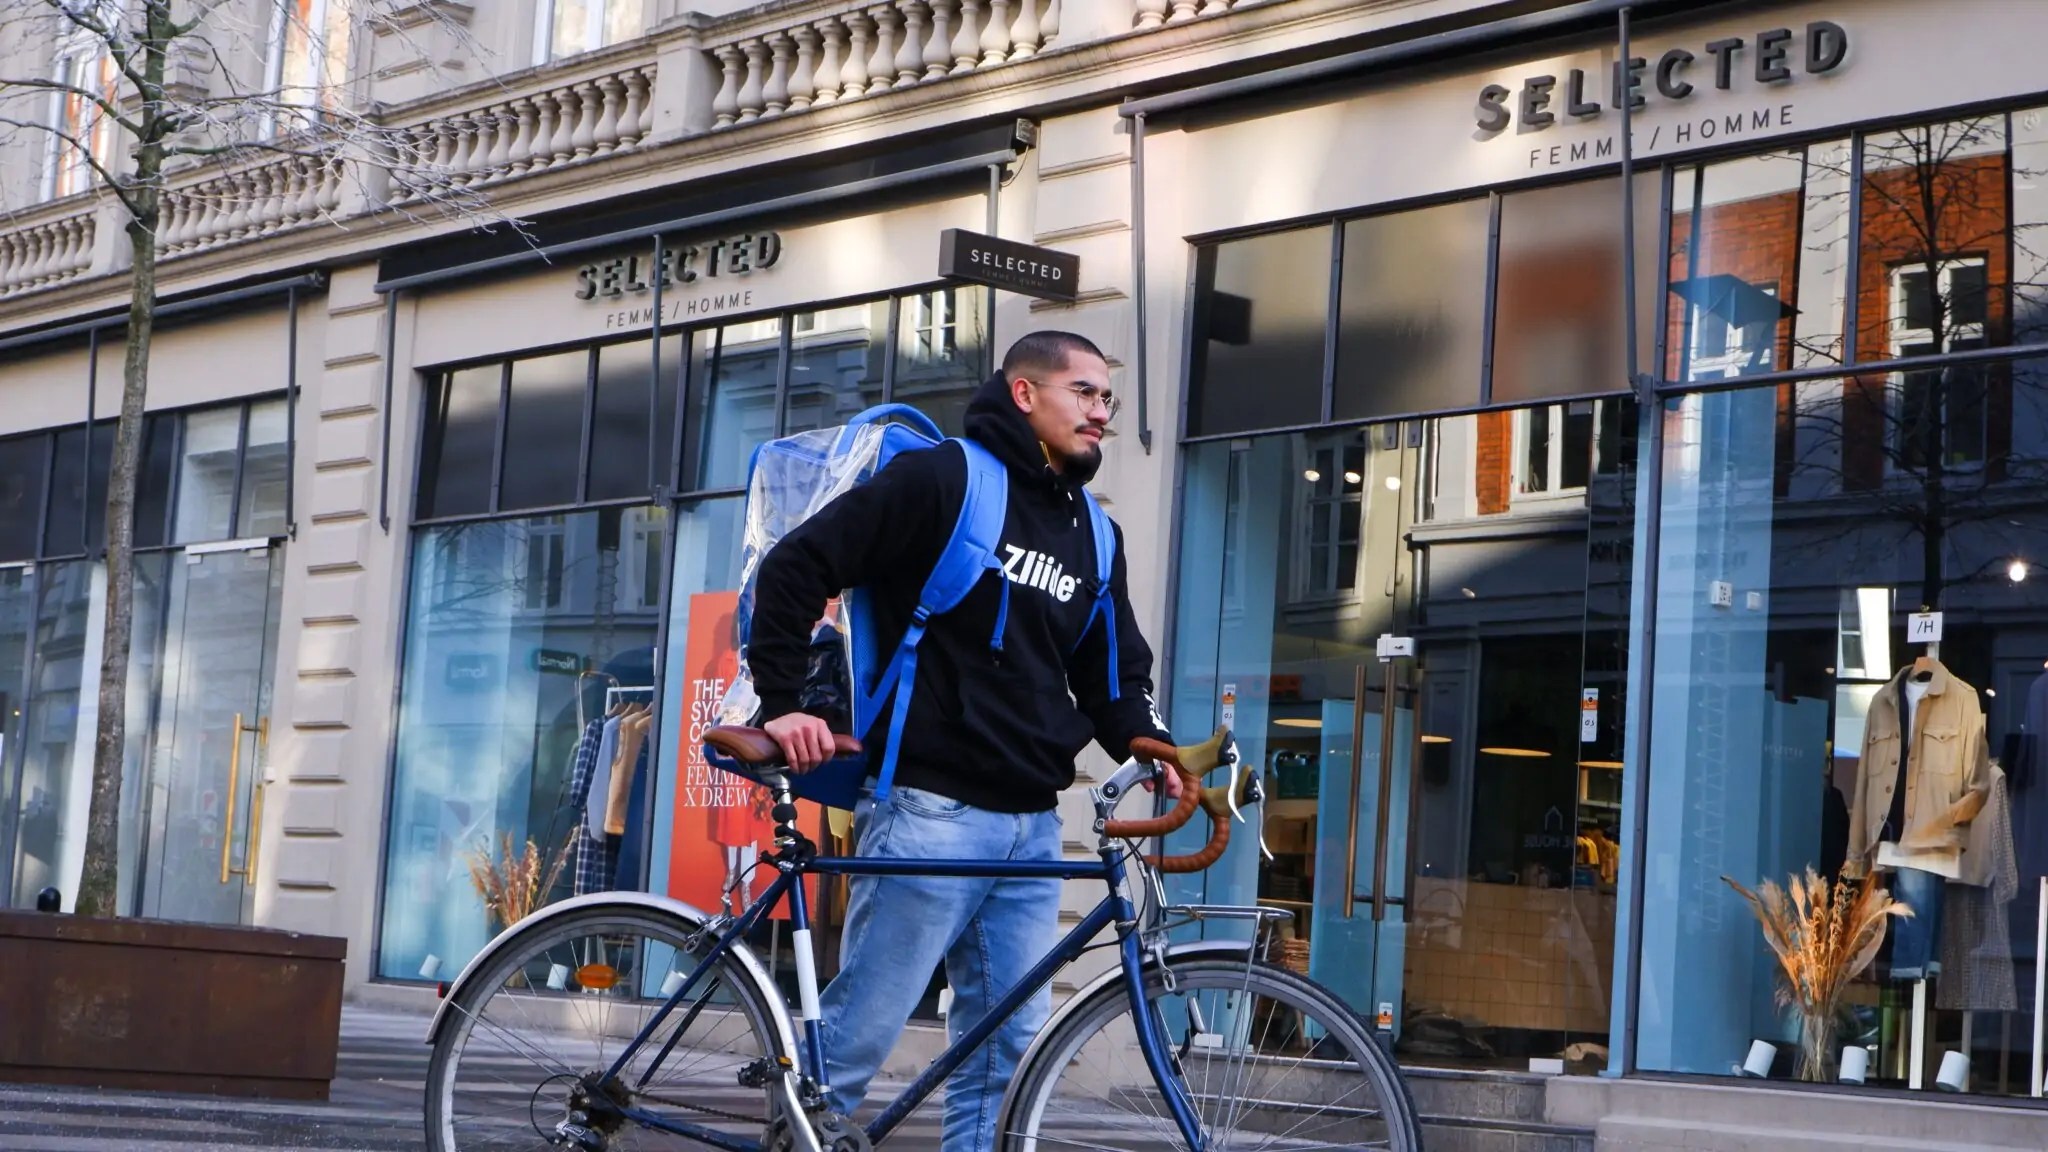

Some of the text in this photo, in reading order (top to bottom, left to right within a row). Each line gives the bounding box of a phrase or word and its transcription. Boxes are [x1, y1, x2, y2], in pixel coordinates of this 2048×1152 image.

[1477, 20, 1848, 133] SELECTED
[1529, 132, 1633, 169] FEMM
[1676, 105, 1794, 144] HOMME
[575, 231, 781, 300] SELECTED
[970, 249, 1062, 281] SELECTED
[687, 290, 752, 316] HOMME
[692, 678, 725, 700] THE
[683, 786, 752, 807] X DREW
